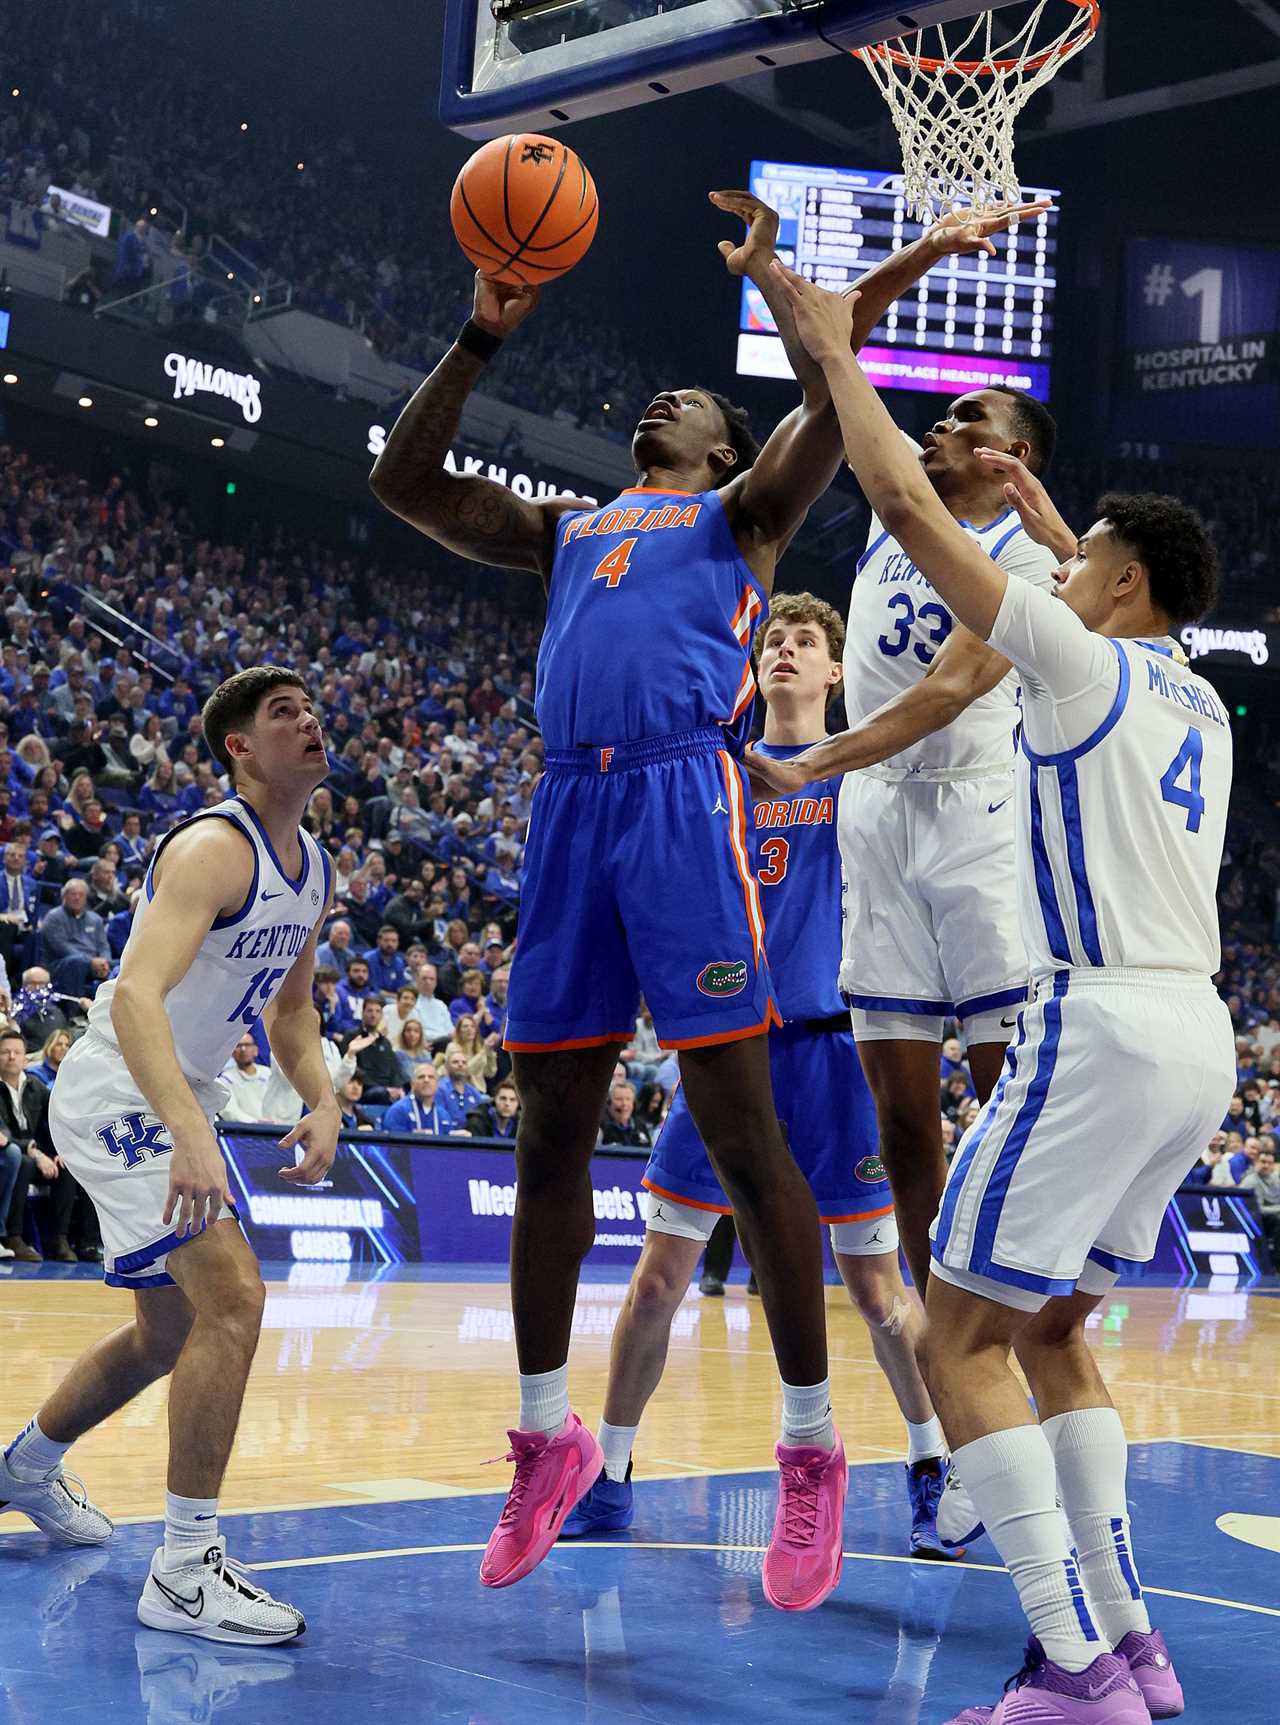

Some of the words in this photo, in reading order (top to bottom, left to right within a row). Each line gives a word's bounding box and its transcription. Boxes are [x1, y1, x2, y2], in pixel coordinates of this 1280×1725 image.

[1144, 264, 1224, 345] #1
[940, 368, 989, 384] HEALTH
[1135, 344, 1238, 371] HOSPITAL
[1242, 340, 1266, 359] IN
[1142, 362, 1258, 390] KENTUCKY
[562, 504, 702, 547] FLORIDA
[592, 537, 639, 588] 4
[878, 592, 953, 664] 33
[1146, 659, 1226, 727] MITCHELL
[600, 747, 615, 773] F
[1160, 726, 1205, 834] 4
[753, 796, 834, 830] ORIDA
[757, 837, 790, 886] 3
[225, 923, 311, 959] KENTUC
[227, 967, 288, 1025] 15
[96, 1112, 175, 1170] UK
[468, 1179, 518, 1217] Mee
[593, 1186, 635, 1221] eets
